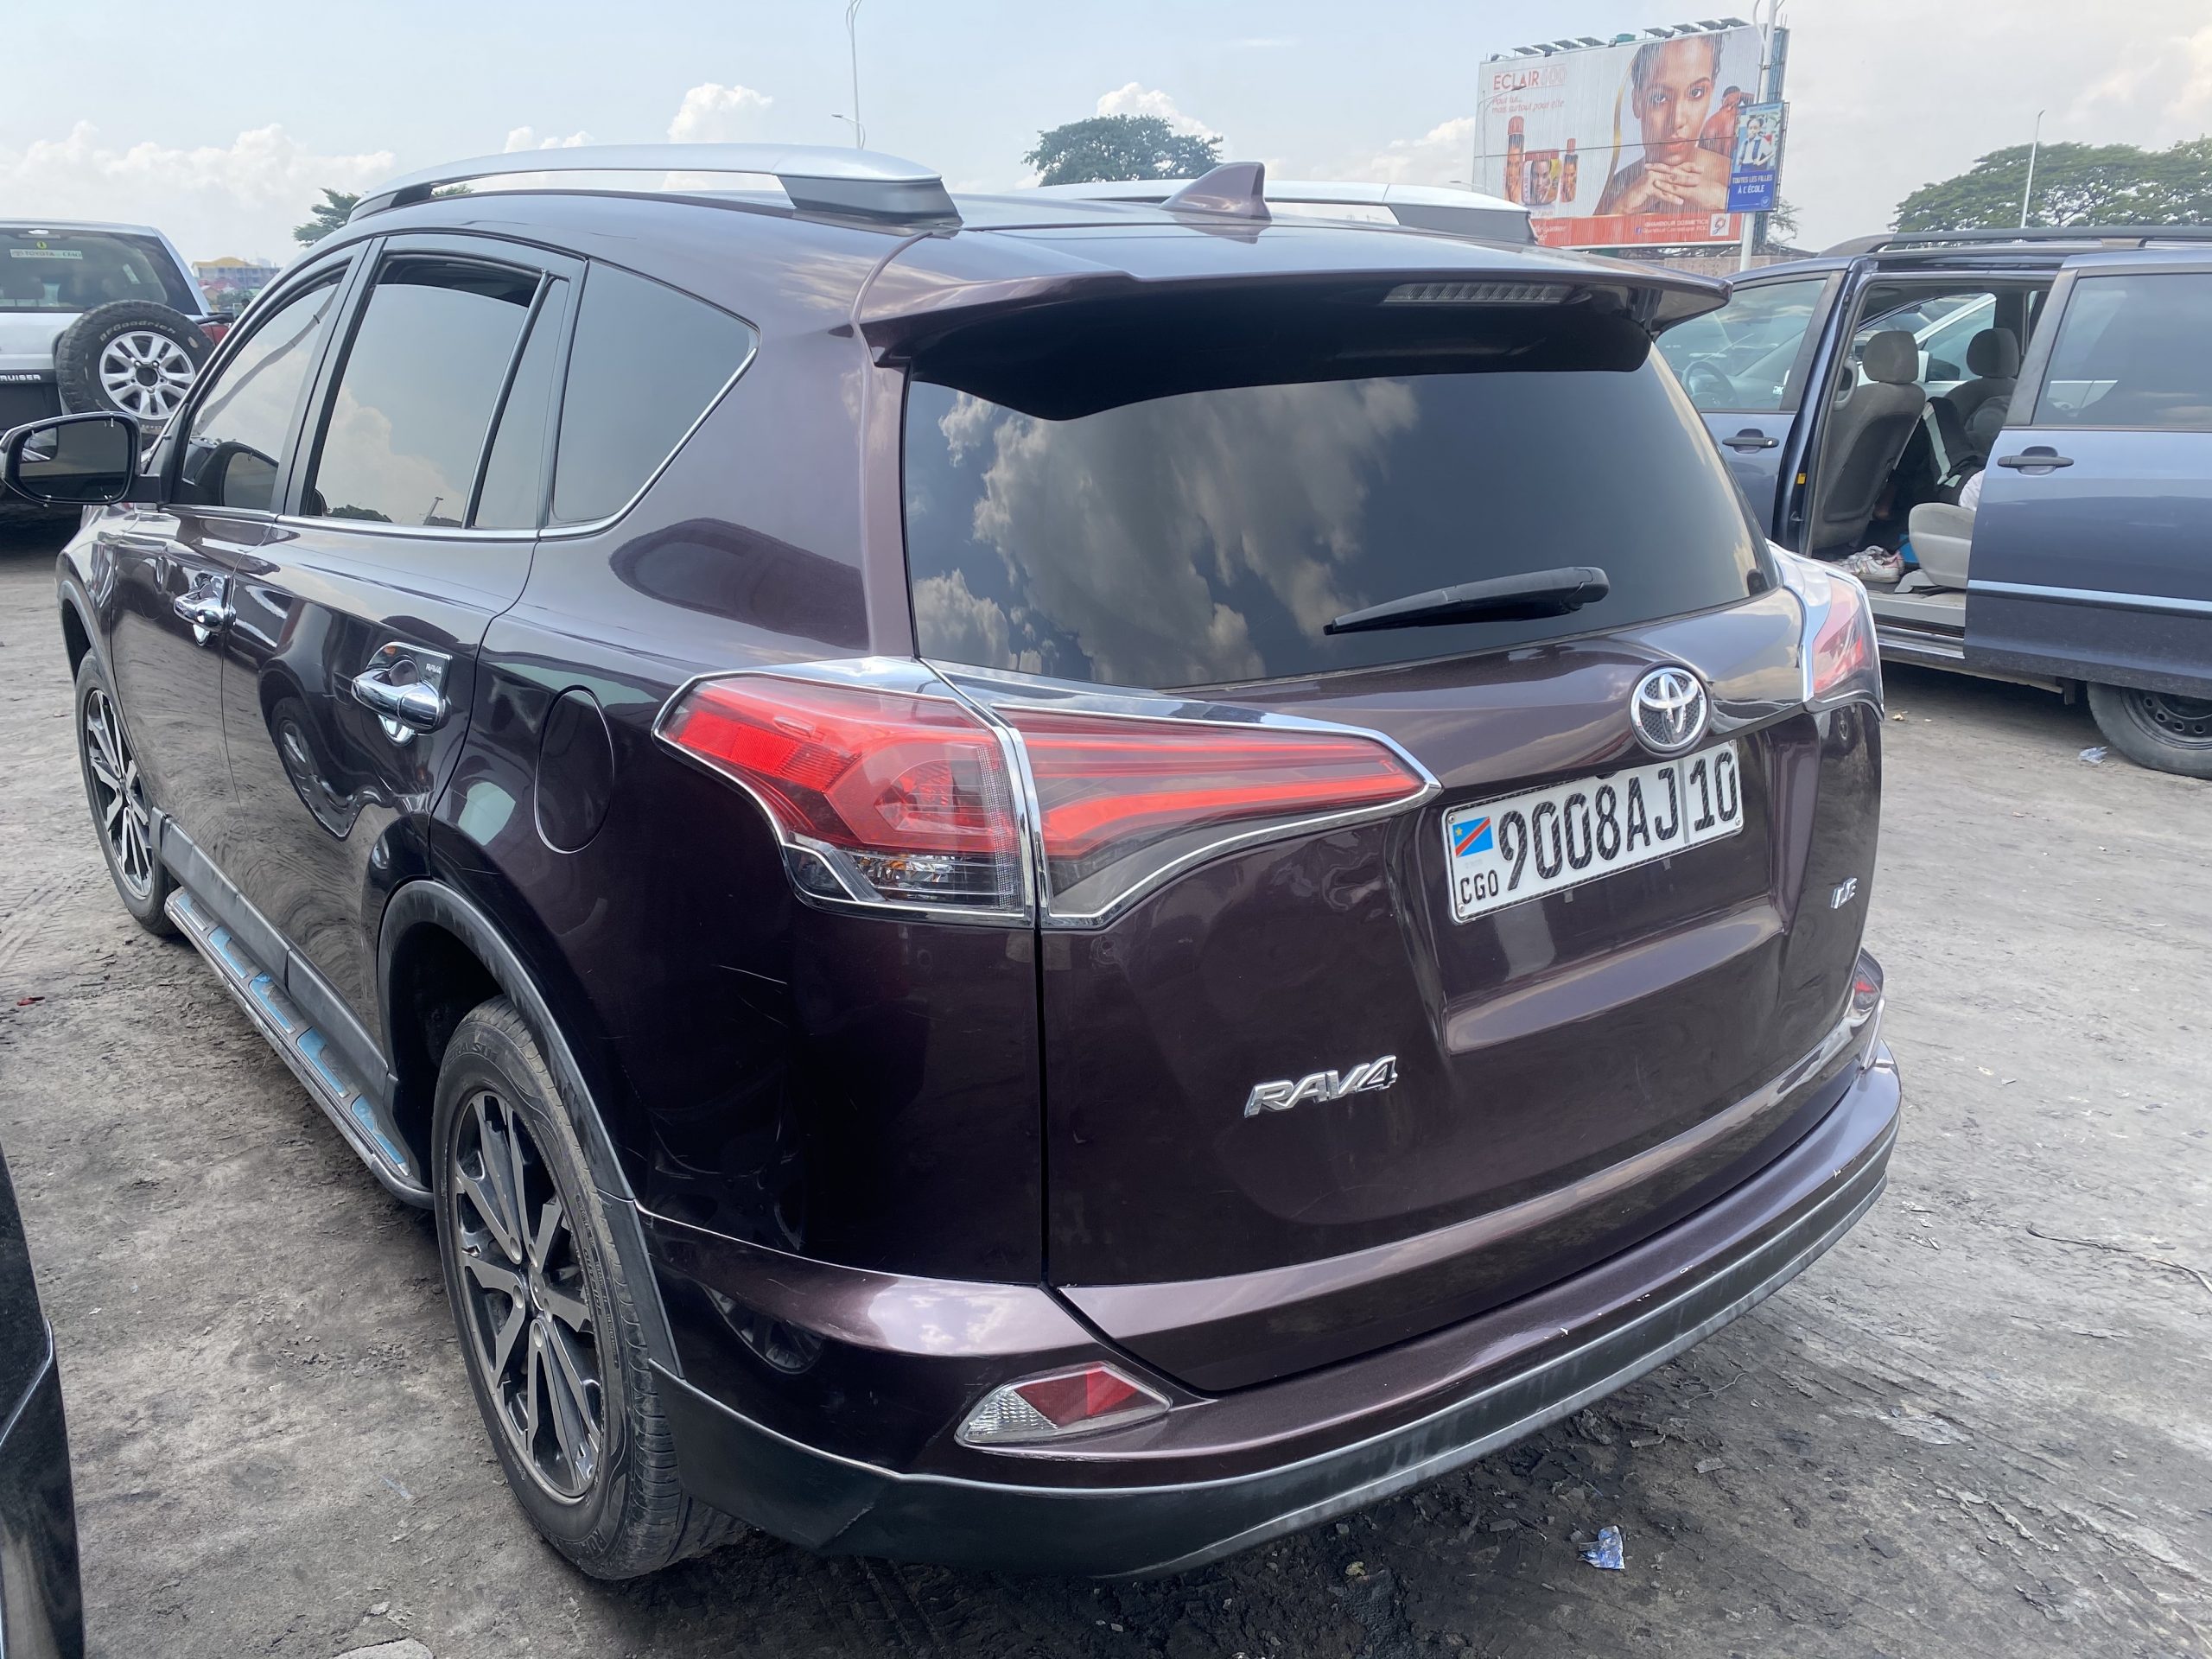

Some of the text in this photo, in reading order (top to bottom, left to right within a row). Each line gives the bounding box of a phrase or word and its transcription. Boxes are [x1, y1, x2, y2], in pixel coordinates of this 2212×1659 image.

[1493, 70, 1539, 91] ECLAIR
[1509, 103, 1531, 112] surtout
[99, 320, 176, 342] BFGoodrich
[0, 373, 41, 382] RUISER
[1459, 868, 1499, 905] CGO
[1243, 1054, 1398, 1118] RAV4
